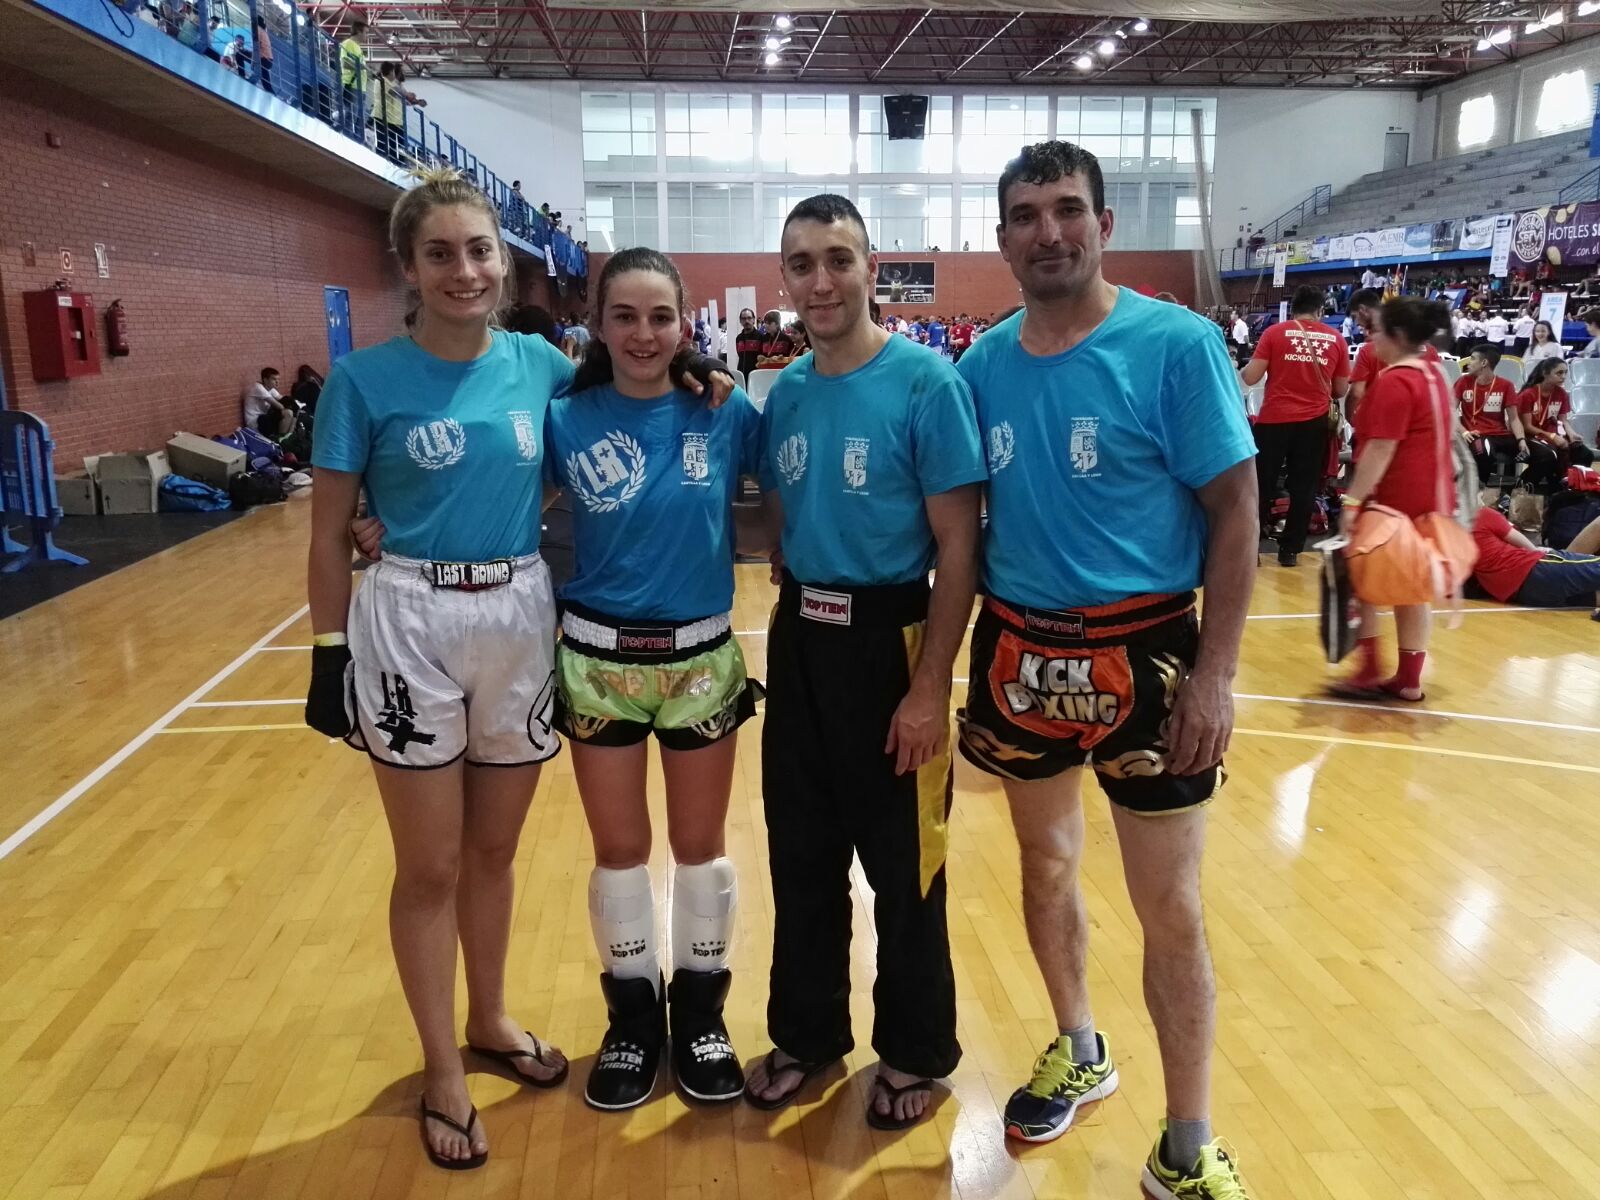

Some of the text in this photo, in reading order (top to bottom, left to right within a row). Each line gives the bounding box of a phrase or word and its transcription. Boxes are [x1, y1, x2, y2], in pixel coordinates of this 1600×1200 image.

[1547, 224, 1589, 241] HOTELES
[1549, 307, 1557, 321] 7
[436, 562, 509, 586] LAST ROUND
[620, 636, 672, 648] TOPTEN
[1019, 652, 1095, 694] KICK
[610, 944, 646, 958] TOP TEN
[692, 947, 710, 957] TOP
[692, 1044, 715, 1056] TOP
[600, 1052, 643, 1067] TOP TEN
